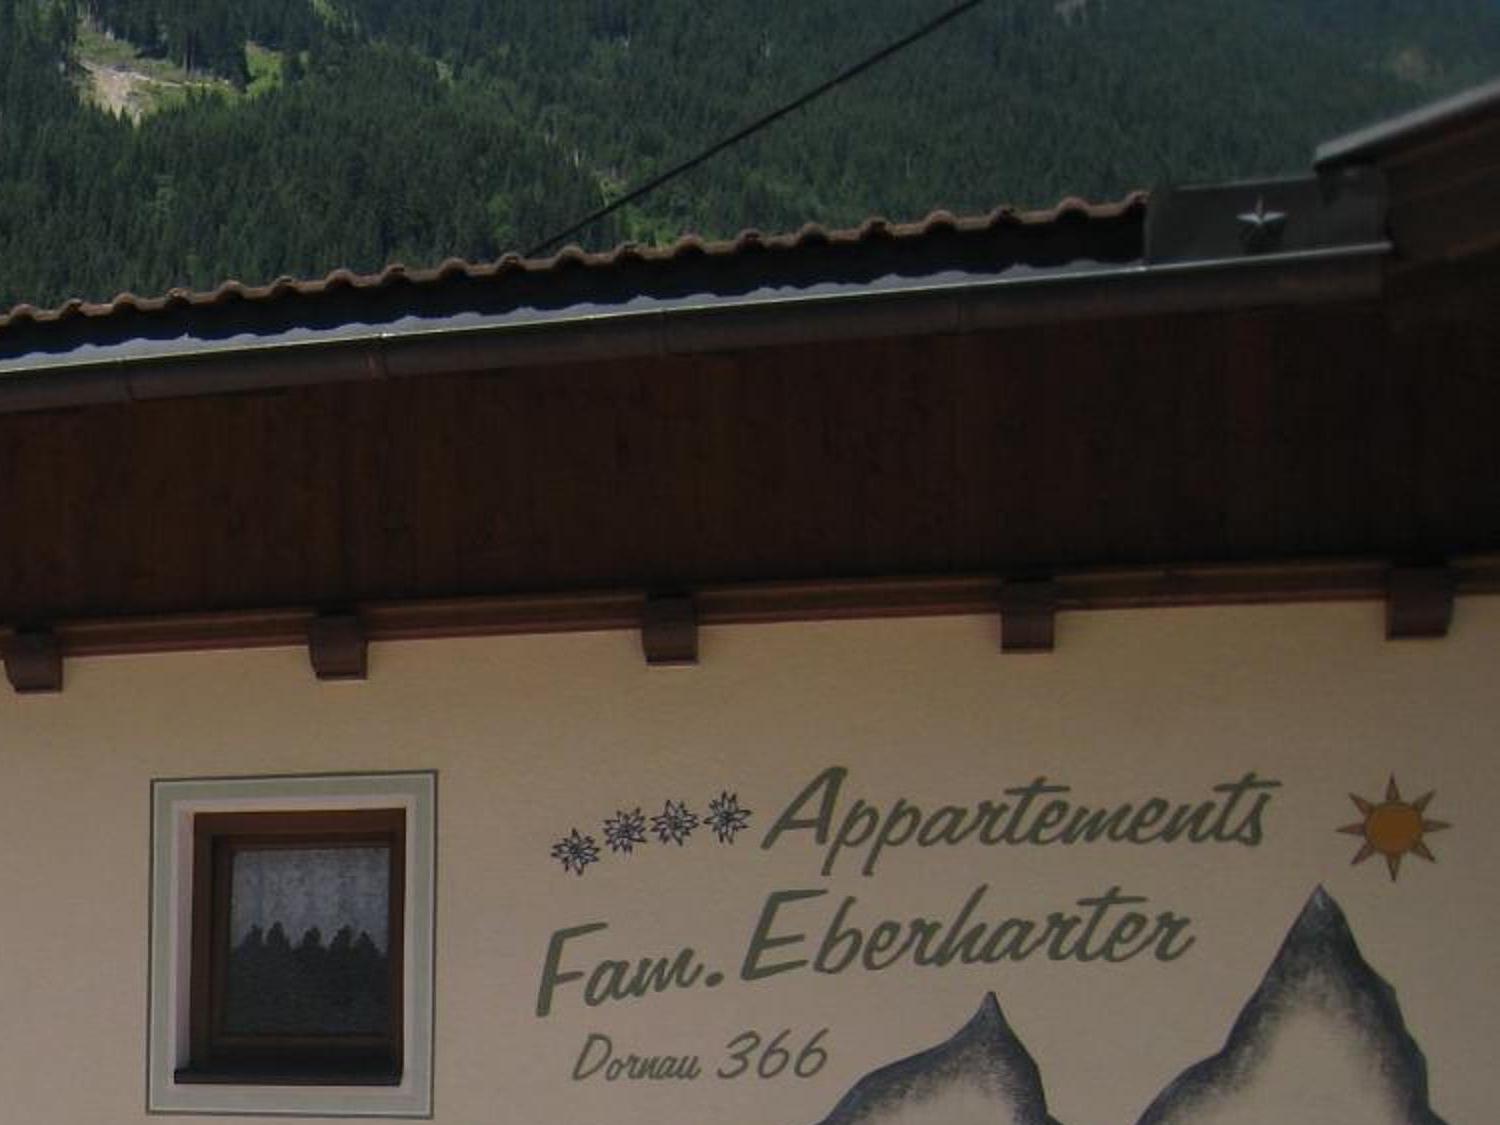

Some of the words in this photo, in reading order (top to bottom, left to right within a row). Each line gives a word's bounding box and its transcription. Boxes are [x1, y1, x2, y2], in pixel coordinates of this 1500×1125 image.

[760, 766, 1283, 877] Appartements
[534, 921, 725, 1018] Fam.
[739, 883, 1196, 981] Eberharter
[571, 1033, 701, 1082] Dornau
[715, 1028, 830, 1080] 366
